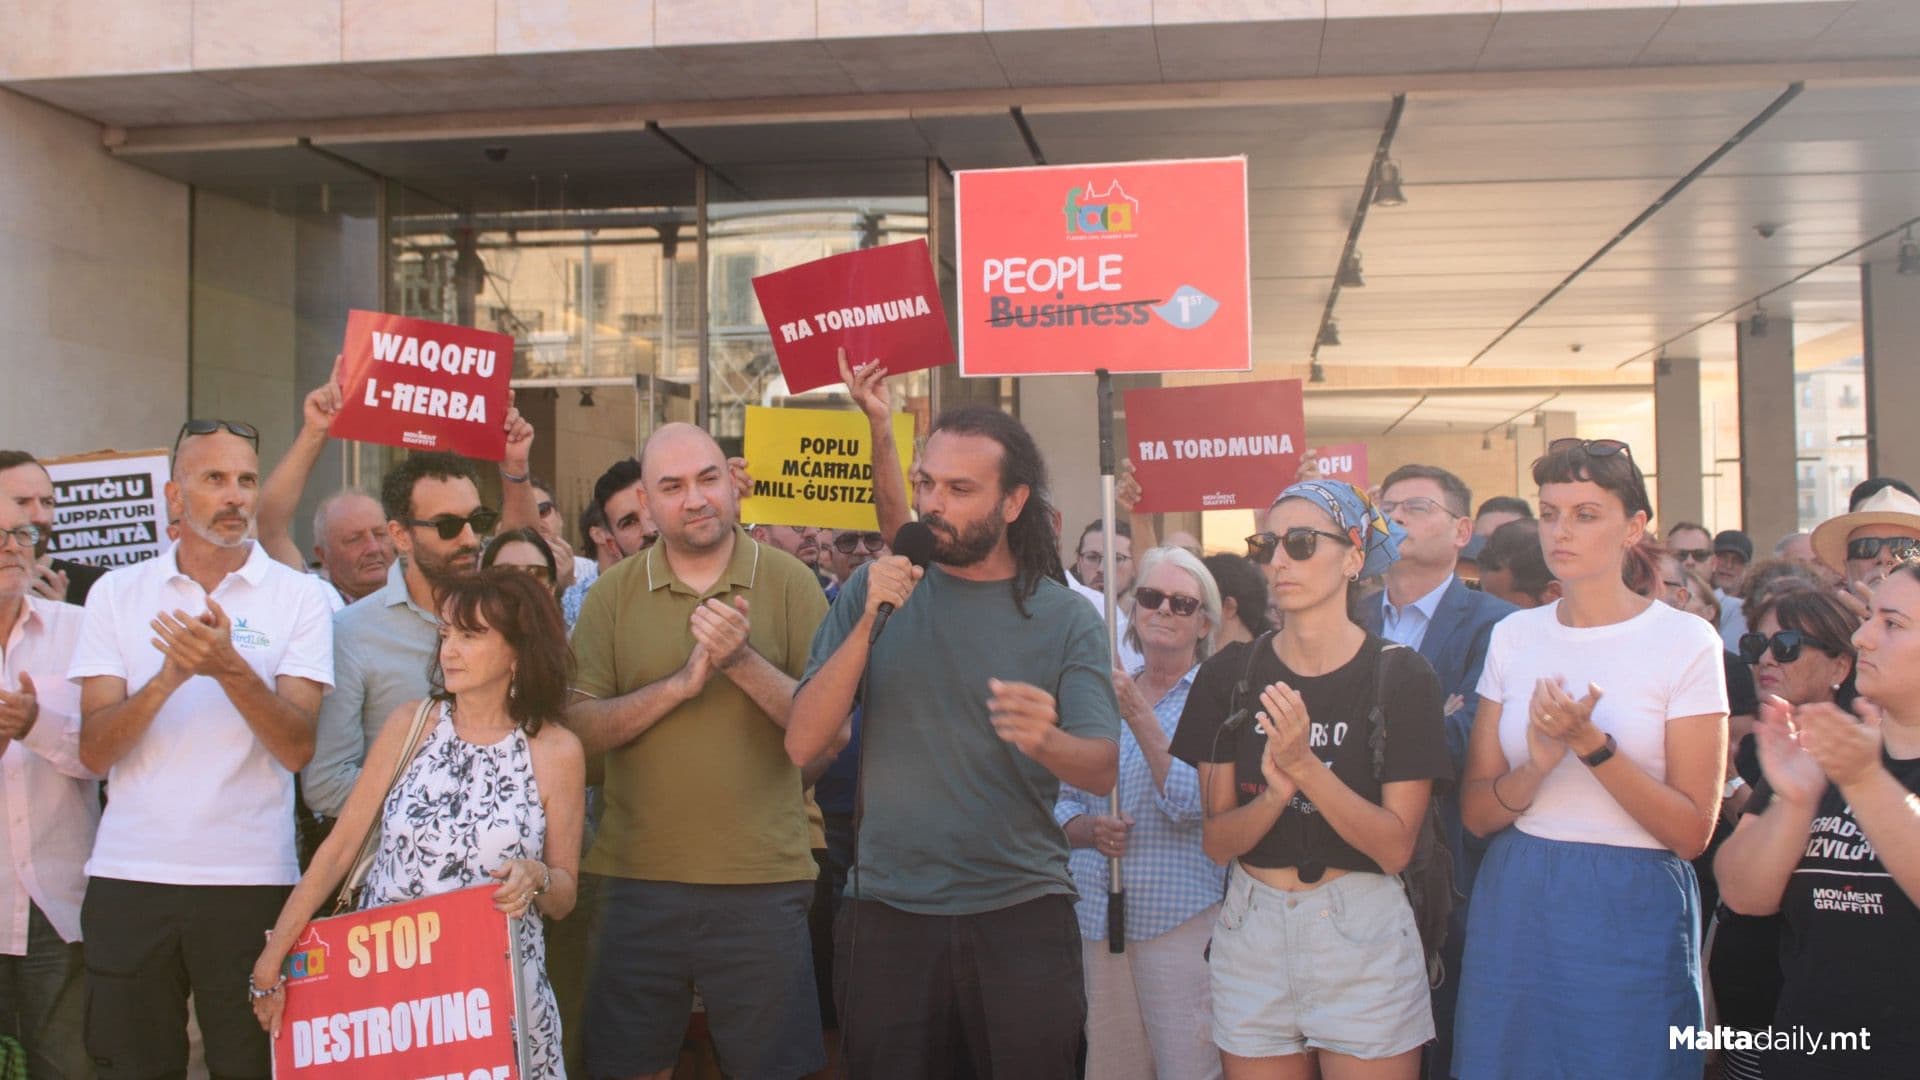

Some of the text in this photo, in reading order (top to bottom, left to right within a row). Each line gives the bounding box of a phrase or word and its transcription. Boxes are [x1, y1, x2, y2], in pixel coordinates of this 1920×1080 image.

[983, 254, 1123, 293] PEOPLE
[815, 295, 931, 333] TORDMUNA
[990, 292, 1150, 329] Business
[372, 331, 496, 378] WAQQFU
[364, 378, 486, 424] L-ĦERBA
[800, 437, 859, 457] POPLU
[1172, 434, 1294, 460] TORDMUNA
[125, 479, 145, 497] U
[1813, 887, 1883, 904] MOVIMENT
[347, 911, 441, 978] STOP
[292, 988, 493, 1068] DESTROYING
